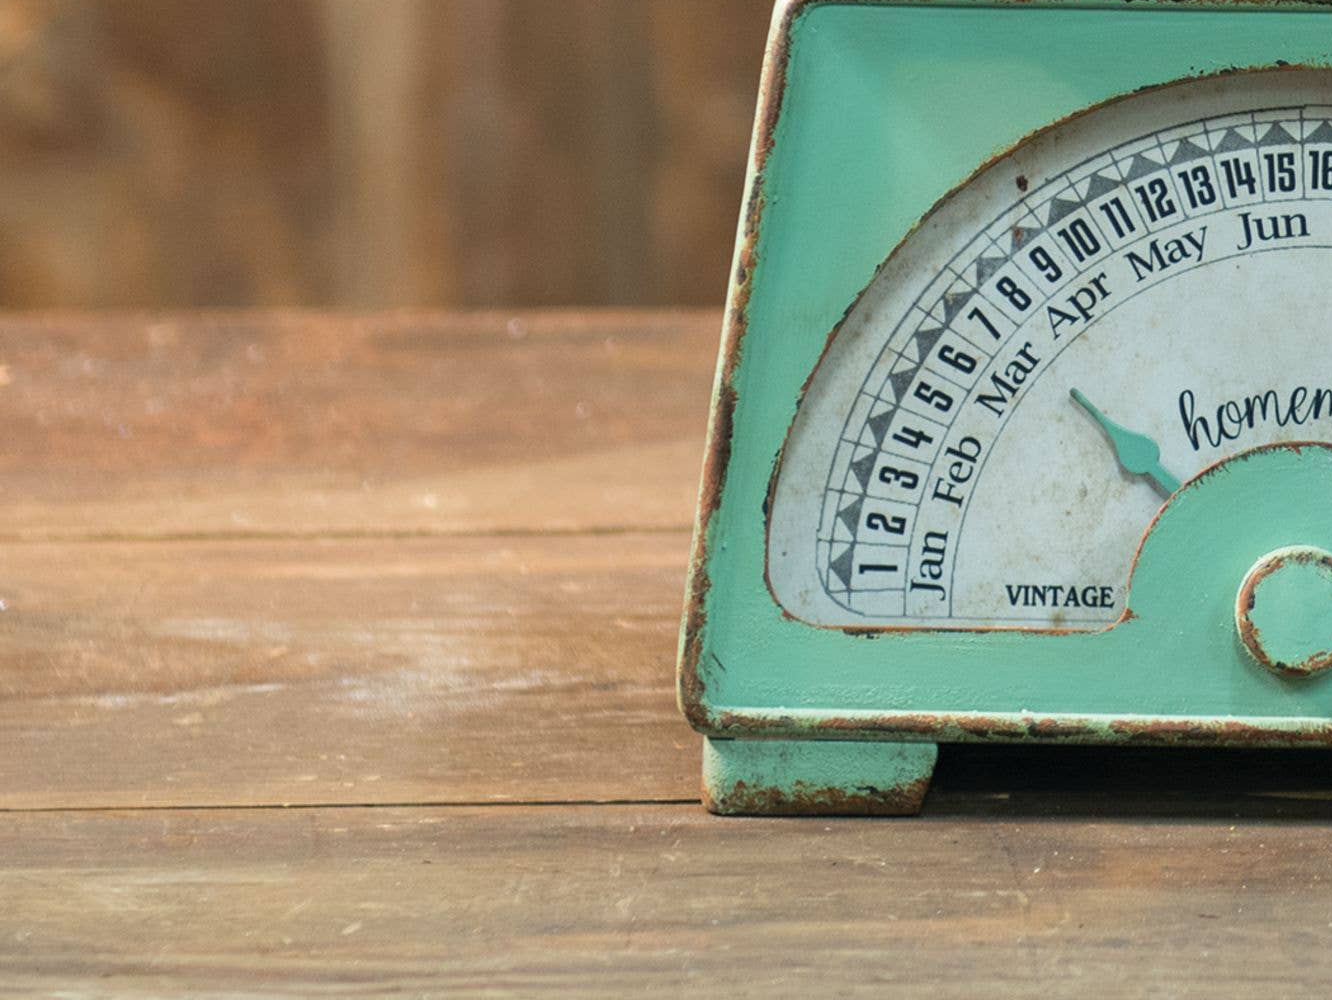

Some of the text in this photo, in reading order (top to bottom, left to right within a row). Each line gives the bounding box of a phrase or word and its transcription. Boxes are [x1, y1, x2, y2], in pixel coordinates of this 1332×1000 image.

[1177, 168, 1217, 209] 13
[1221, 158, 1256, 198] 14
[1265, 152, 1297, 191] 15
[1135, 178, 1177, 221] 12
[1100, 199, 1136, 238] 11
[1058, 218, 1100, 262] 10
[1029, 245, 1062, 283] 9
[996, 276, 1033, 312] 8
[967, 309, 1002, 340] 7
[937, 345, 977, 374] 6
[910, 531, 948, 600] Jan
[933, 435, 982, 508] Feb
[975, 341, 1041, 418] Mar
[1045, 272, 1112, 339] Apr
[1125, 225, 1209, 283] May
[1237, 213, 1310, 250] Jun
[914, 381, 953, 413] 5
[892, 424, 933, 449] 4
[879, 466, 919, 489] 3
[866, 511, 907, 534] 2
[858, 562, 899, 575] 1
[1006, 585, 1115, 607] VINTAGE
